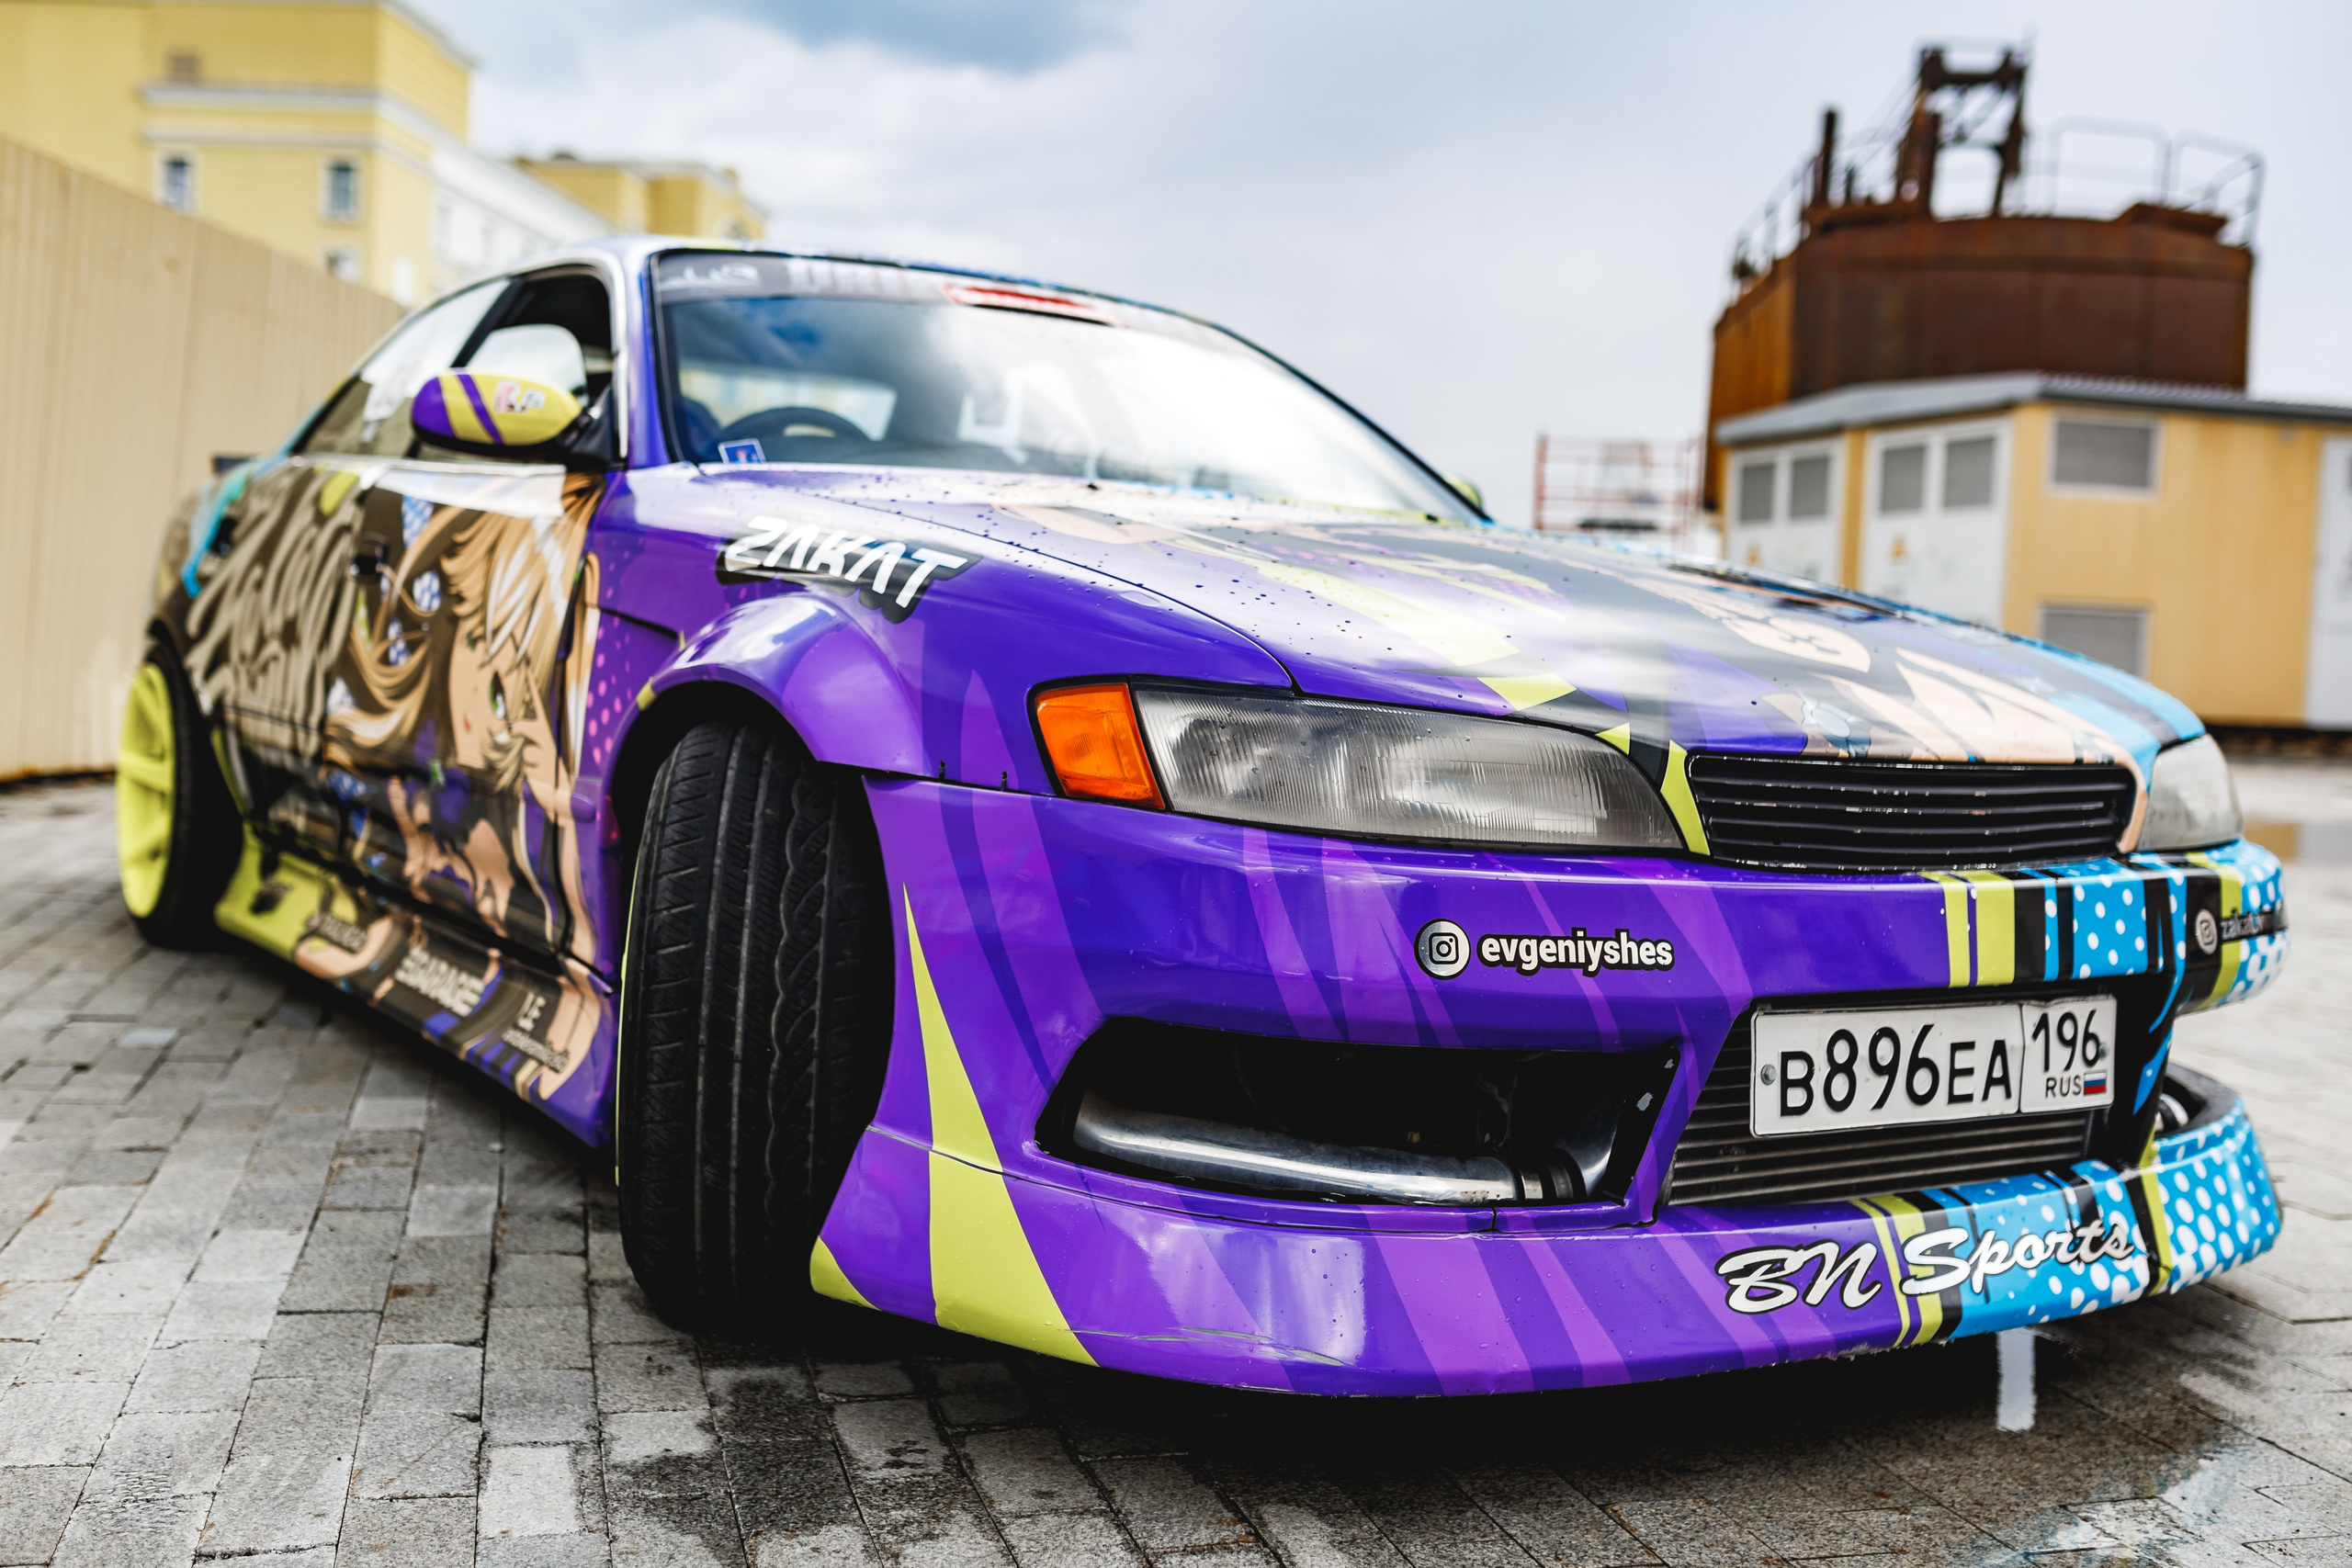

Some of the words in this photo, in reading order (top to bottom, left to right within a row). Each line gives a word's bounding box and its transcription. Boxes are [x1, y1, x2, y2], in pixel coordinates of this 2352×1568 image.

[725, 515, 968, 609] ZAKAT
[1480, 931, 1674, 972] evgeniyshes
[2030, 1009, 2101, 1073] 196
[2045, 1075, 2083, 1099] RUS
[1716, 1241, 1883, 1314] BN
[1900, 1218, 2135, 1296] Sports
